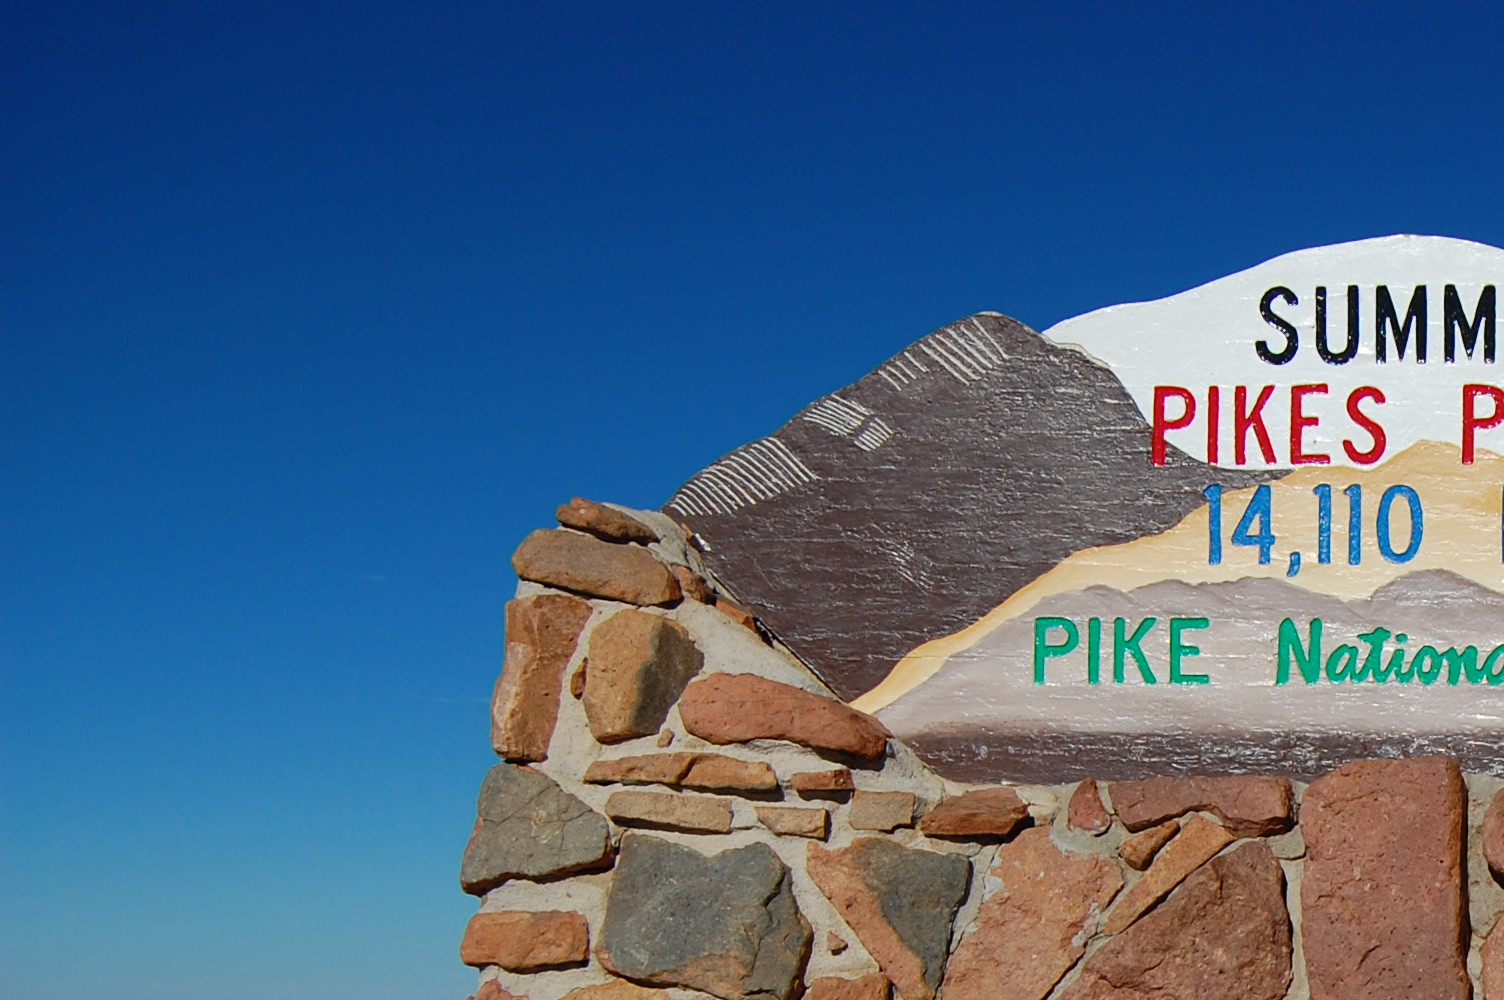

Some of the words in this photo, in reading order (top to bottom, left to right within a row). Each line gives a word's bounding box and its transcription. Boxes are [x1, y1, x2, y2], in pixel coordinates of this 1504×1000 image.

[1151, 384, 1387, 466] PIKES
[1203, 484, 1423, 577] 14,110
[1034, 617, 1210, 686] PIKE
